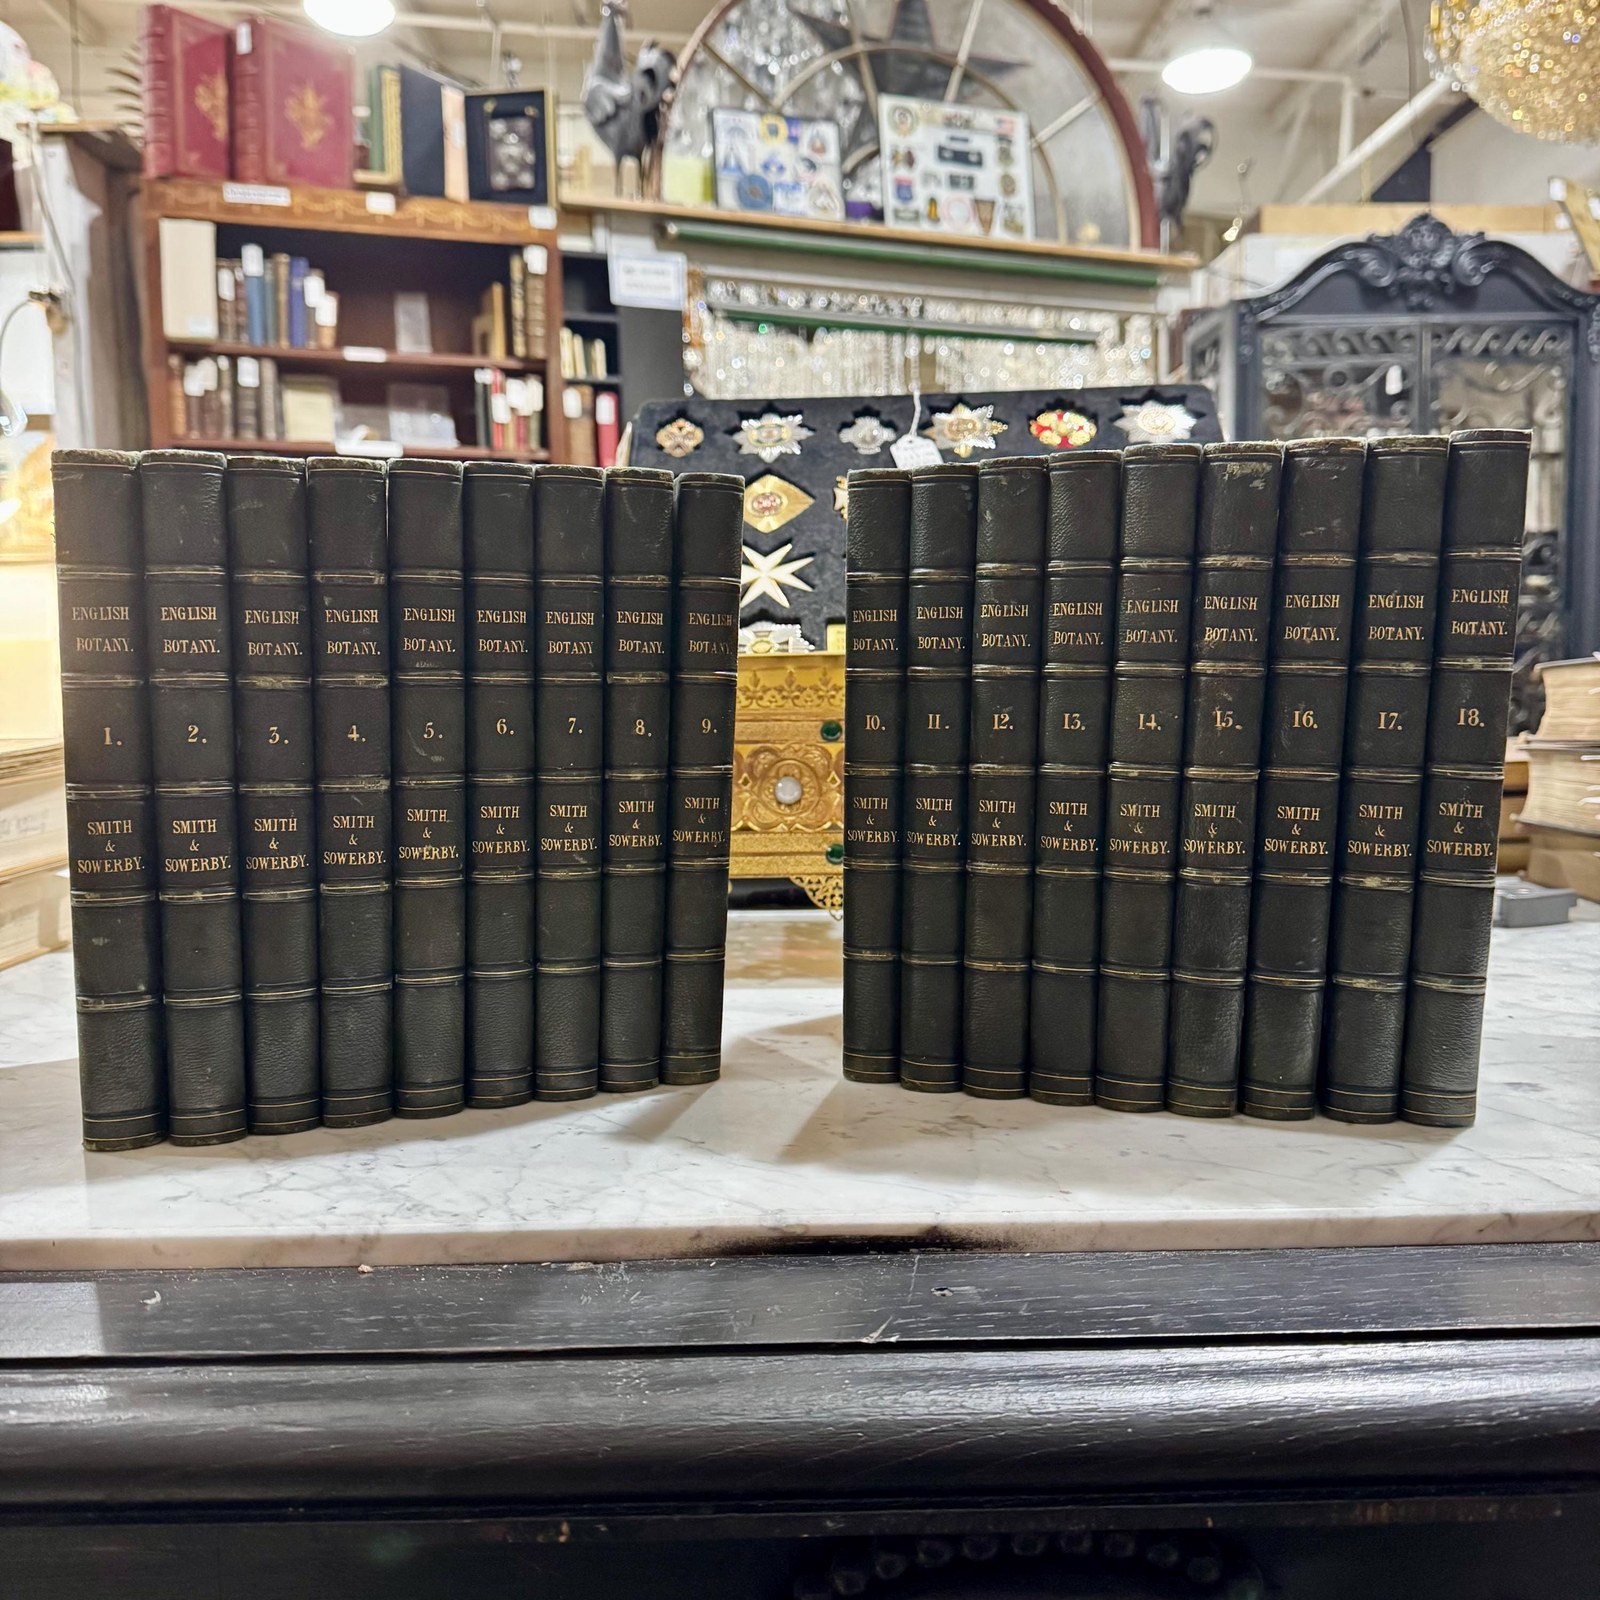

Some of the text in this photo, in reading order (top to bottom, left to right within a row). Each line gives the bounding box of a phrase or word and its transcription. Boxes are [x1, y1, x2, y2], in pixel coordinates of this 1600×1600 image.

[1204, 596, 1258, 611] ENGLISH
[1285, 595, 1340, 608] ENGLISH
[1368, 595, 1425, 609] ENGLISH
[1452, 589, 1509, 604] ENGLISH
[72, 606, 130, 621] ENGLISH
[916, 606, 963, 619] ENGLISH
[981, 604, 1029, 618] ENGLISH
[1053, 602, 1103, 616] ENGLISH
[1126, 600, 1179, 613] ENGLISH
[161, 607, 217, 621] ENGLISH
[245, 610, 299, 624] ENGLISH
[325, 610, 378, 623] ENGLISH
[404, 608, 455, 623] ENGLISH
[477, 610, 527, 624] ENGLISH
[546, 612, 594, 626] ENGLISH
[616, 612, 663, 626] ENGLISH
[688, 613, 732, 626] ENGLISH
[852, 609, 897, 623] ENGLISH
[1204, 628, 1258, 642] BOTANY.
[1284, 626, 1340, 641] BOTANY.
[1369, 626, 1425, 641] BOTANY.
[1452, 621, 1508, 635] BOTANY.
[918, 636, 966, 650] BOTANY.
[982, 634, 1031, 648] BOTANY.
[1054, 631, 1104, 646] BOTANY.
[1125, 630, 1178, 643] BOTANY.
[76, 637, 134, 653] BOTANY.
[164, 639, 220, 653] BOTANY.
[247, 642, 303, 656] BOTANY.
[327, 641, 381, 655] BOTANY.
[403, 638, 456, 653] BOTANY.
[479, 639, 528, 653] BOTANY.
[618, 639, 664, 654] BOTANY.
[853, 638, 898, 651] BOTANY.
[864, 715, 886, 731] 10.
[927, 714, 950, 729] 11.
[992, 714, 1014, 730] 12.
[1063, 713, 1086, 731] 13.
[1138, 714, 1162, 731] 14.
[1215, 710, 1243, 730] 15.
[1293, 711, 1318, 729] 16.
[1378, 712, 1403, 731] 17.
[1457, 709, 1484, 728] 18.
[423, 722, 443, 739] 5.
[496, 719, 515, 735] 6.
[568, 718, 583, 734] 7.
[636, 719, 652, 737] 8.
[702, 719, 718, 734] 9.
[103, 727, 122, 745] 1.
[188, 725, 207, 744] 2.
[269, 727, 289, 744] 3.
[348, 725, 366, 742] 4.
[619, 801, 655, 813] SMITH
[684, 797, 719, 809] SMITH
[854, 798, 888, 810] SMITH
[916, 798, 953, 811] SMITH
[979, 800, 1016, 813] SMITH
[1049, 802, 1088, 815] SMITH
[407, 809, 447, 822] SMITH
[481, 806, 520, 819] SMITH
[550, 805, 587, 818] SMITH
[1120, 804, 1160, 818] SMITH
[1194, 804, 1236, 818] SMITH
[1277, 806, 1321, 821] SMITH
[1359, 804, 1403, 820] SMITH
[1439, 803, 1483, 818] SMITH
[173, 819, 217, 833] SMITH
[254, 819, 298, 832] SMITH
[333, 816, 375, 829] SMITH
[632, 819, 640, 830] &
[698, 815, 706, 824] &
[867, 816, 874, 824] &
[928, 816, 937, 826] &
[992, 818, 1001, 828] &
[1064, 821, 1073, 832] &
[87, 820, 132, 835] SMITH
[423, 828, 432, 838] &
[496, 824, 505, 835] &
[564, 823, 573, 833] &
[1134, 823, 1143, 834] &
[1209, 823, 1218, 837] &
[1292, 824, 1301, 836] &
[1375, 826, 1385, 837] &
[1454, 822, 1464, 834] &
[105, 840, 115, 852] &
[190, 840, 199, 851] &
[269, 838, 279, 849] &
[348, 835, 358, 846] &
[472, 840, 530, 854] SOWERBY.
[541, 838, 598, 852] SOWERBY.
[609, 834, 663, 848] SOWERBY.
[907, 834, 961, 846] SOWERBY.
[971, 833, 1027, 847] SOWERBY.
[1040, 836, 1099, 851] SOWERBY.
[1110, 839, 1170, 854] SOWERBY.
[1184, 839, 1246, 854] SOWERBY.
[1264, 838, 1328, 854] SOWERBY.
[399, 846, 459, 860] SOWERBY.
[1348, 841, 1412, 857] SOWERBY.
[1427, 840, 1493, 857] SOWERBY.
[165, 856, 231, 871] SOWERBY.
[246, 856, 309, 870] SOWERBY.
[323, 851, 386, 865] SOWERBY.
[77, 857, 145, 874] SOWERBY.
